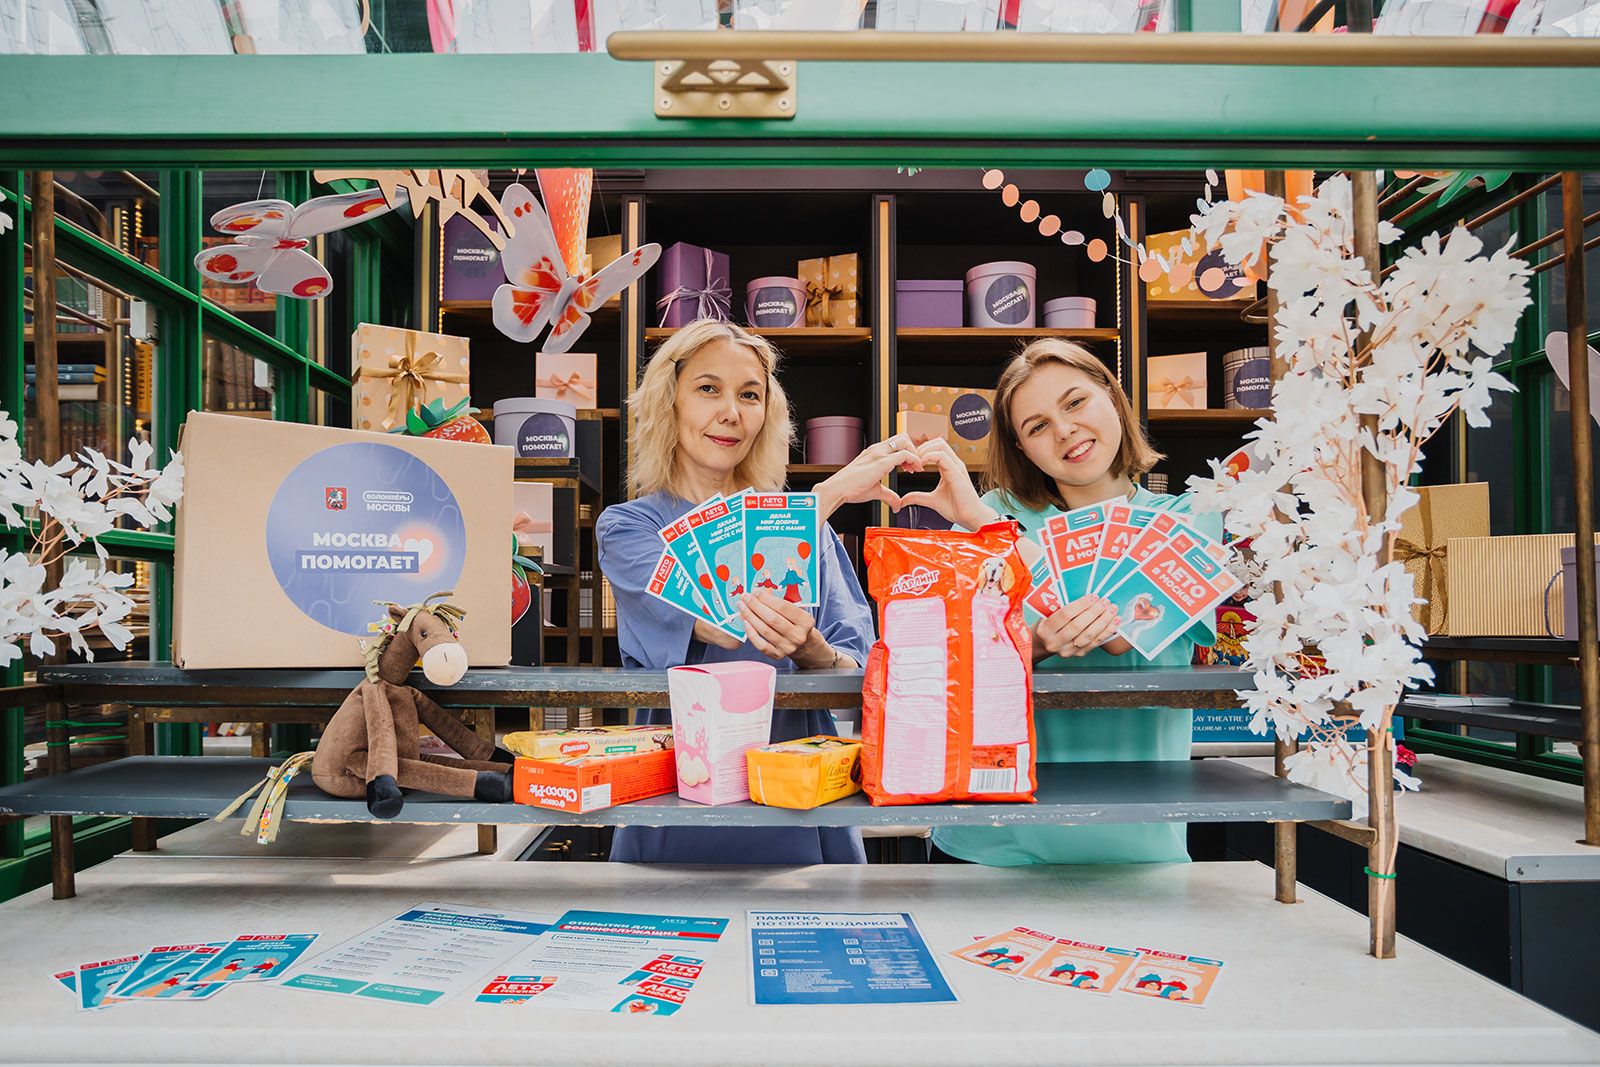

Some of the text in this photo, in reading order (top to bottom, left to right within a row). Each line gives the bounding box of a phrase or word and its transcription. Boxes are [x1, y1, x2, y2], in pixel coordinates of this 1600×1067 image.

[992, 290, 1019, 308] МОСКВА
[992, 295, 1024, 316] ПОМОГАЕТ
[755, 308, 788, 316] ПОМОГАЕТ
[1239, 377, 1270, 385] МОСКВА
[1236, 384, 1271, 393] ПОМОГАЕ
[956, 410, 980, 418] МОСКВА
[954, 415, 985, 426] ПОМОГАЕТ
[522, 443, 562, 451] ПОМОГАЕТ
[366, 503, 410, 512] МОСКВЫ
[705, 505, 723, 517] ЛЕТО
[312, 532, 403, 548] МОСКВА
[1066, 531, 1102, 553] ЛЕТ
[1076, 547, 1098, 559] МОС
[301, 554, 415, 570] ПОМОГАЕТ
[658, 559, 670, 577] ЛЕТО
[1159, 559, 1207, 599] ЛЕТО
[1151, 567, 1196, 607] В МОСКВЕ
[529, 783, 578, 803] Choco-Pie
[568, 920, 631, 929] ОТКРЫТКИ
[562, 925, 681, 937] ВОЕННОСЛУЖАЩИХ
[654, 962, 700, 973] ЛЕТО
[657, 968, 695, 977] МОСКВЕ
[643, 984, 687, 997] ЛЕТО
